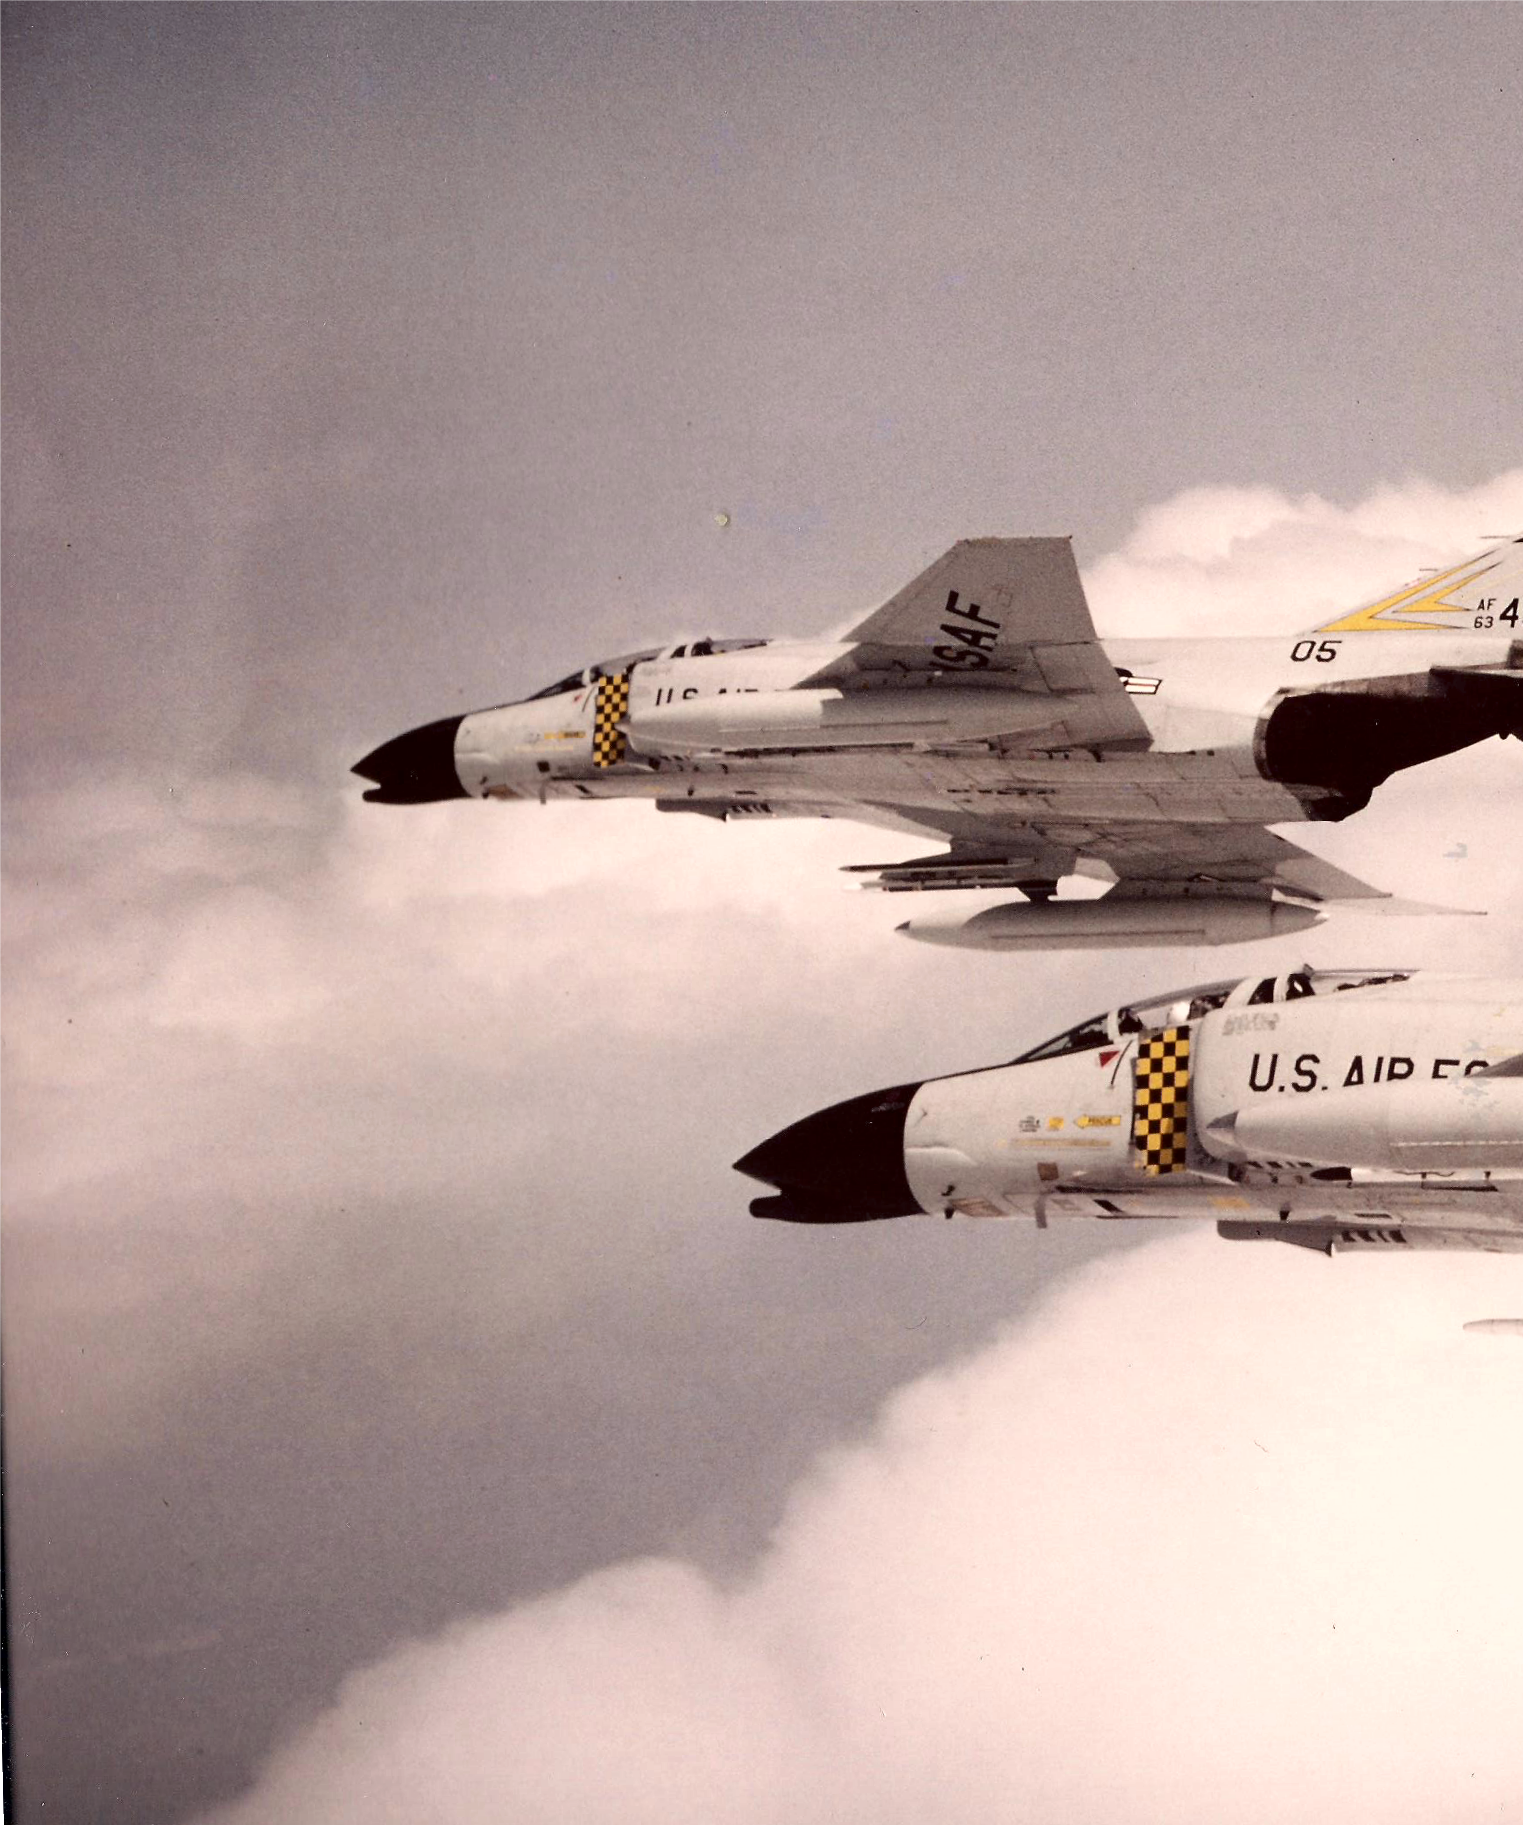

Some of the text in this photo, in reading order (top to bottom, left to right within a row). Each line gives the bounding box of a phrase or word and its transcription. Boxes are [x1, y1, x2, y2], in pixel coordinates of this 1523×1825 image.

[1477, 598, 1497, 611] AF
[928, 590, 1000, 671] SAF
[1473, 615, 1494, 629] 63
[1290, 640, 1342, 663] 05
[1248, 1053, 1328, 1093] U.S.
